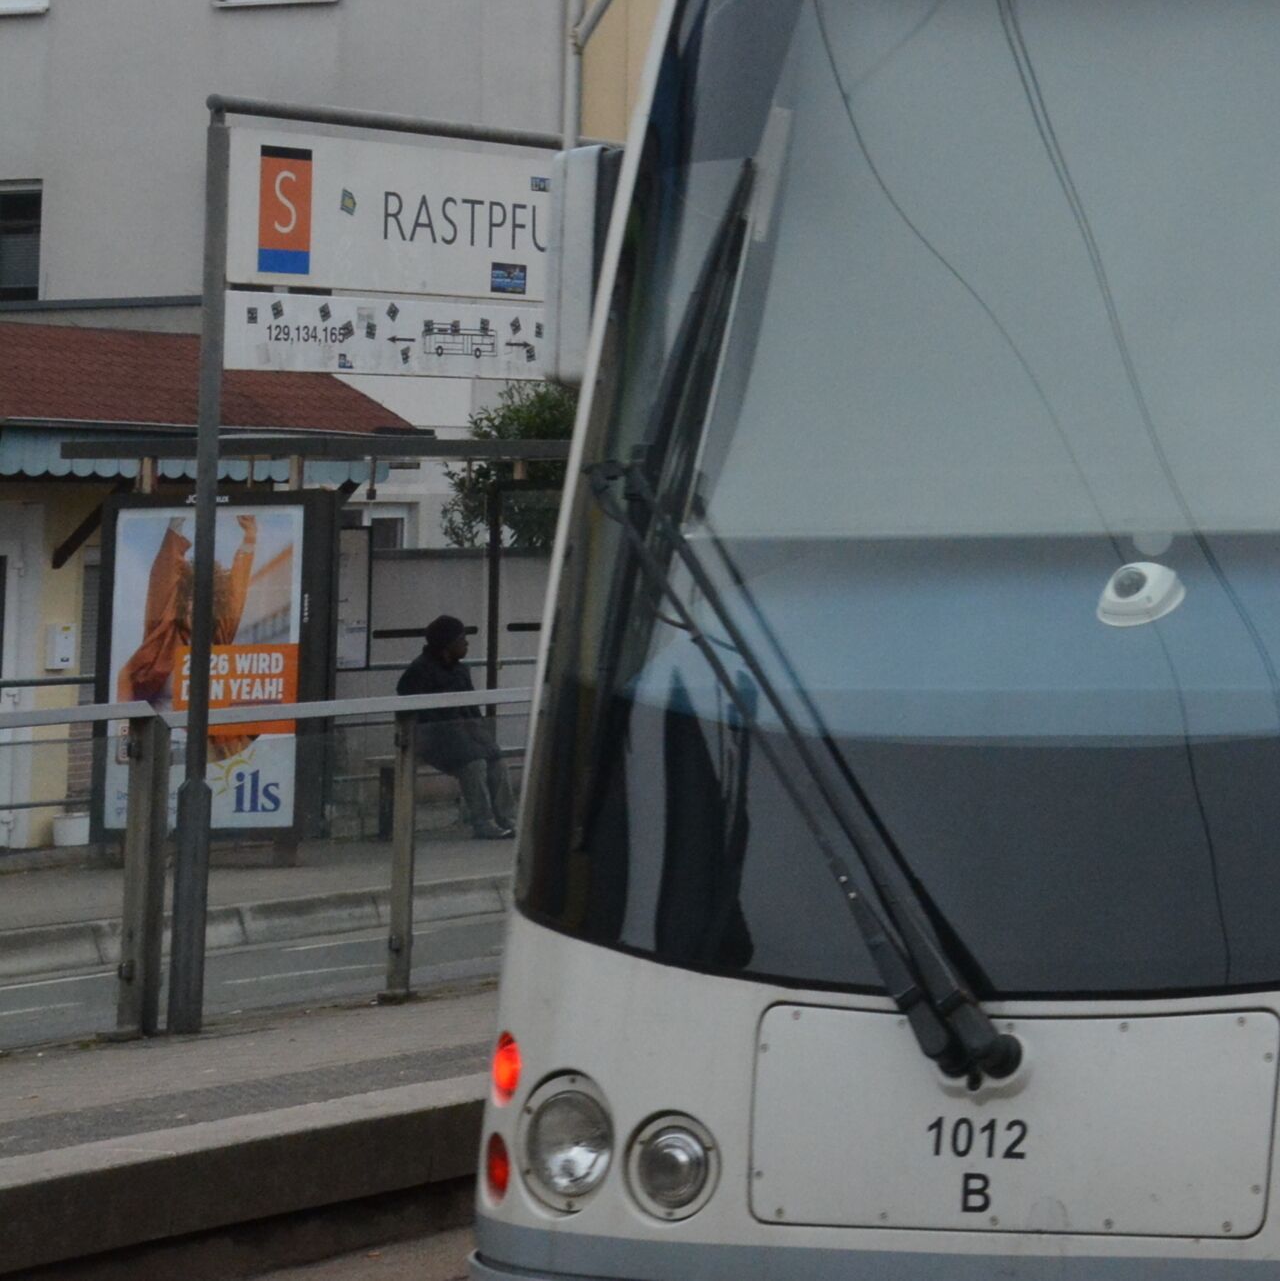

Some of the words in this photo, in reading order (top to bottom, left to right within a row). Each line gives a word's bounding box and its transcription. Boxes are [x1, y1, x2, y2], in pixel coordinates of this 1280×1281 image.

[274, 170, 297, 233] S
[182, 653, 229, 675] 226
[235, 652, 284, 675] WIRD
[230, 678, 284, 700] YEAH!
[232, 769, 281, 813] ils
[927, 1116, 1028, 1160] 1012
[961, 1172, 991, 1213] B
